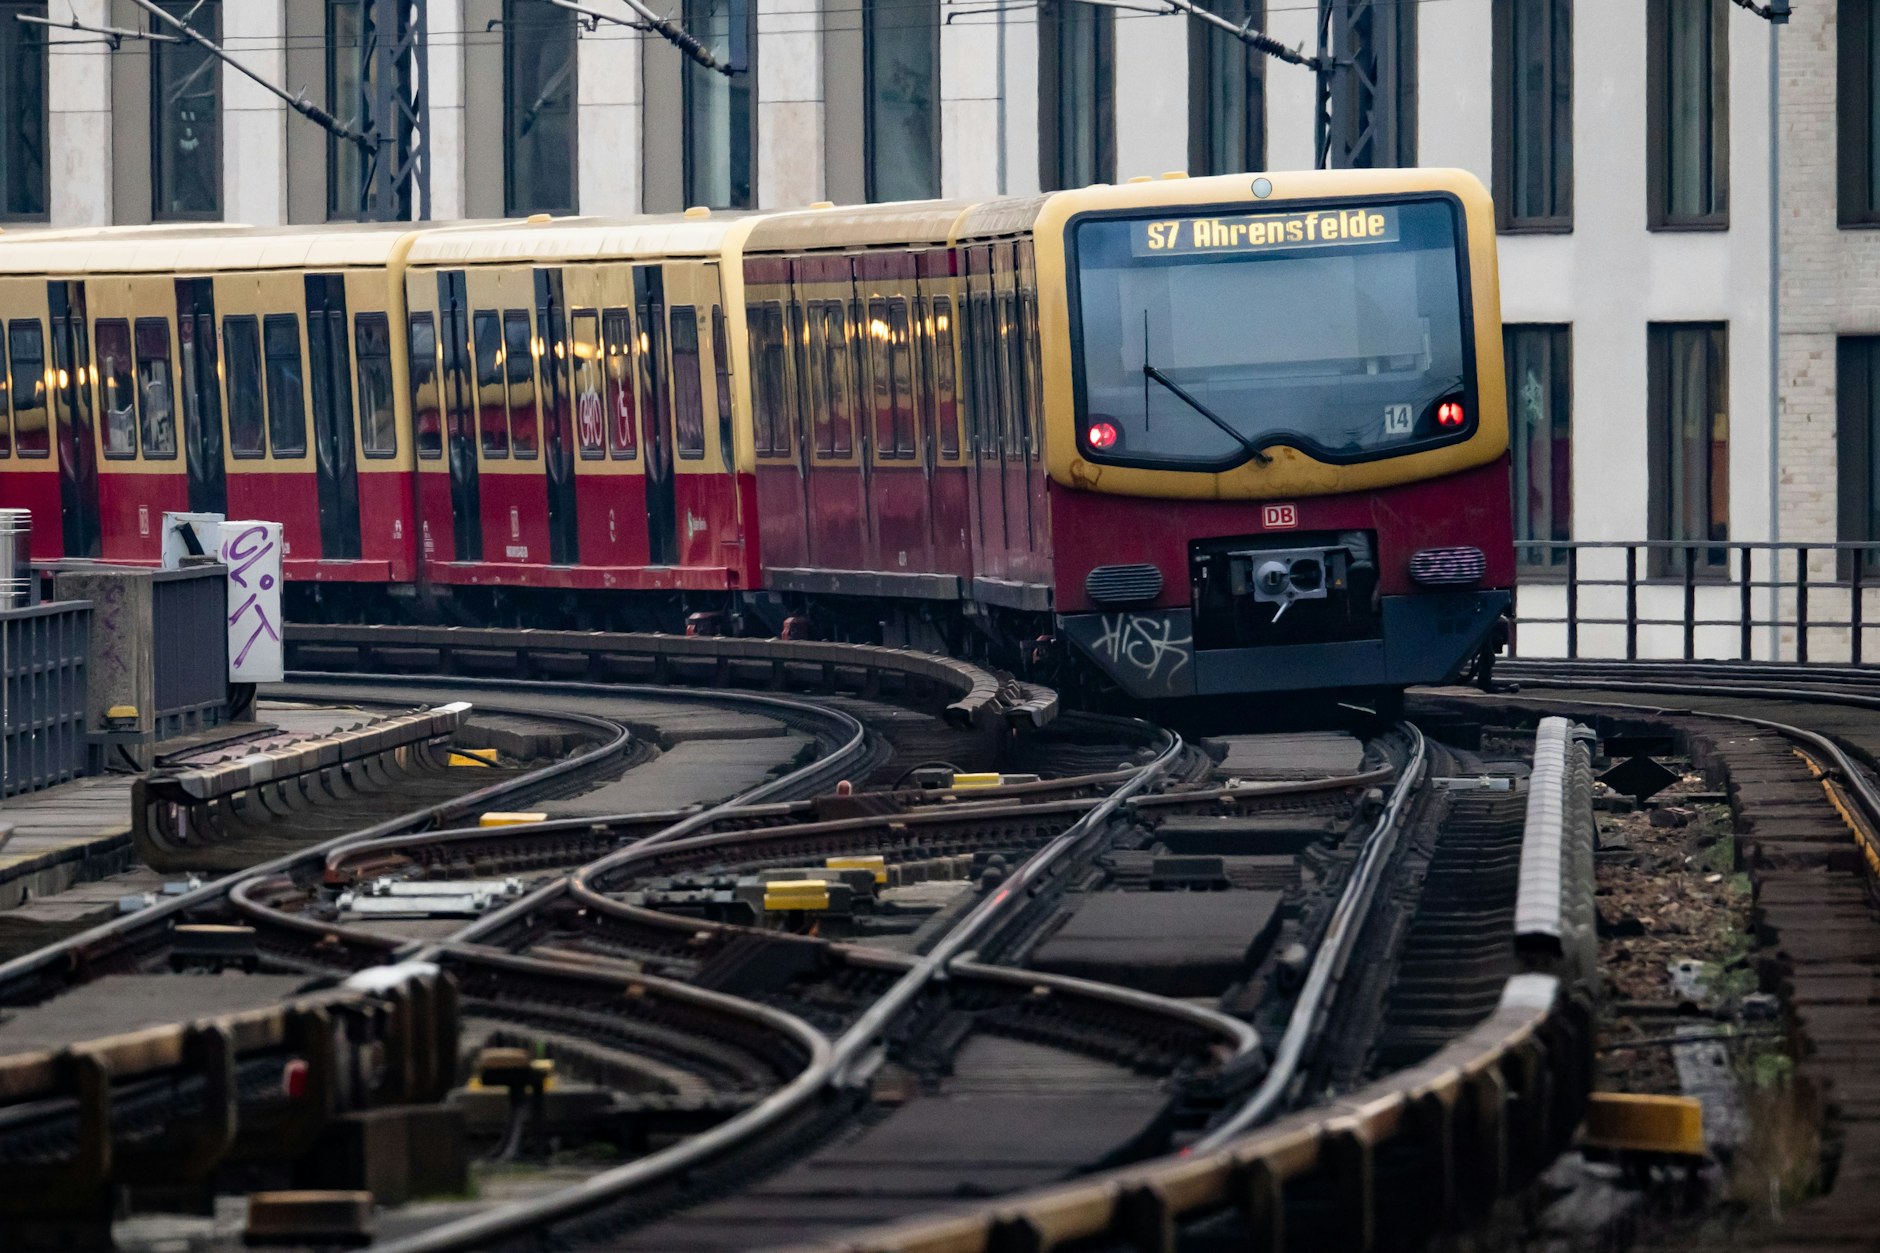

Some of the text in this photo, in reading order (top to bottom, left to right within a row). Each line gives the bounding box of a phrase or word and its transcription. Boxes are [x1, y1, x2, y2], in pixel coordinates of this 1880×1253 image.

[1147, 210, 1385, 249] S7 Ahrensfelde
[1385, 406, 1409, 429] 14
[1266, 507, 1294, 525] DB
